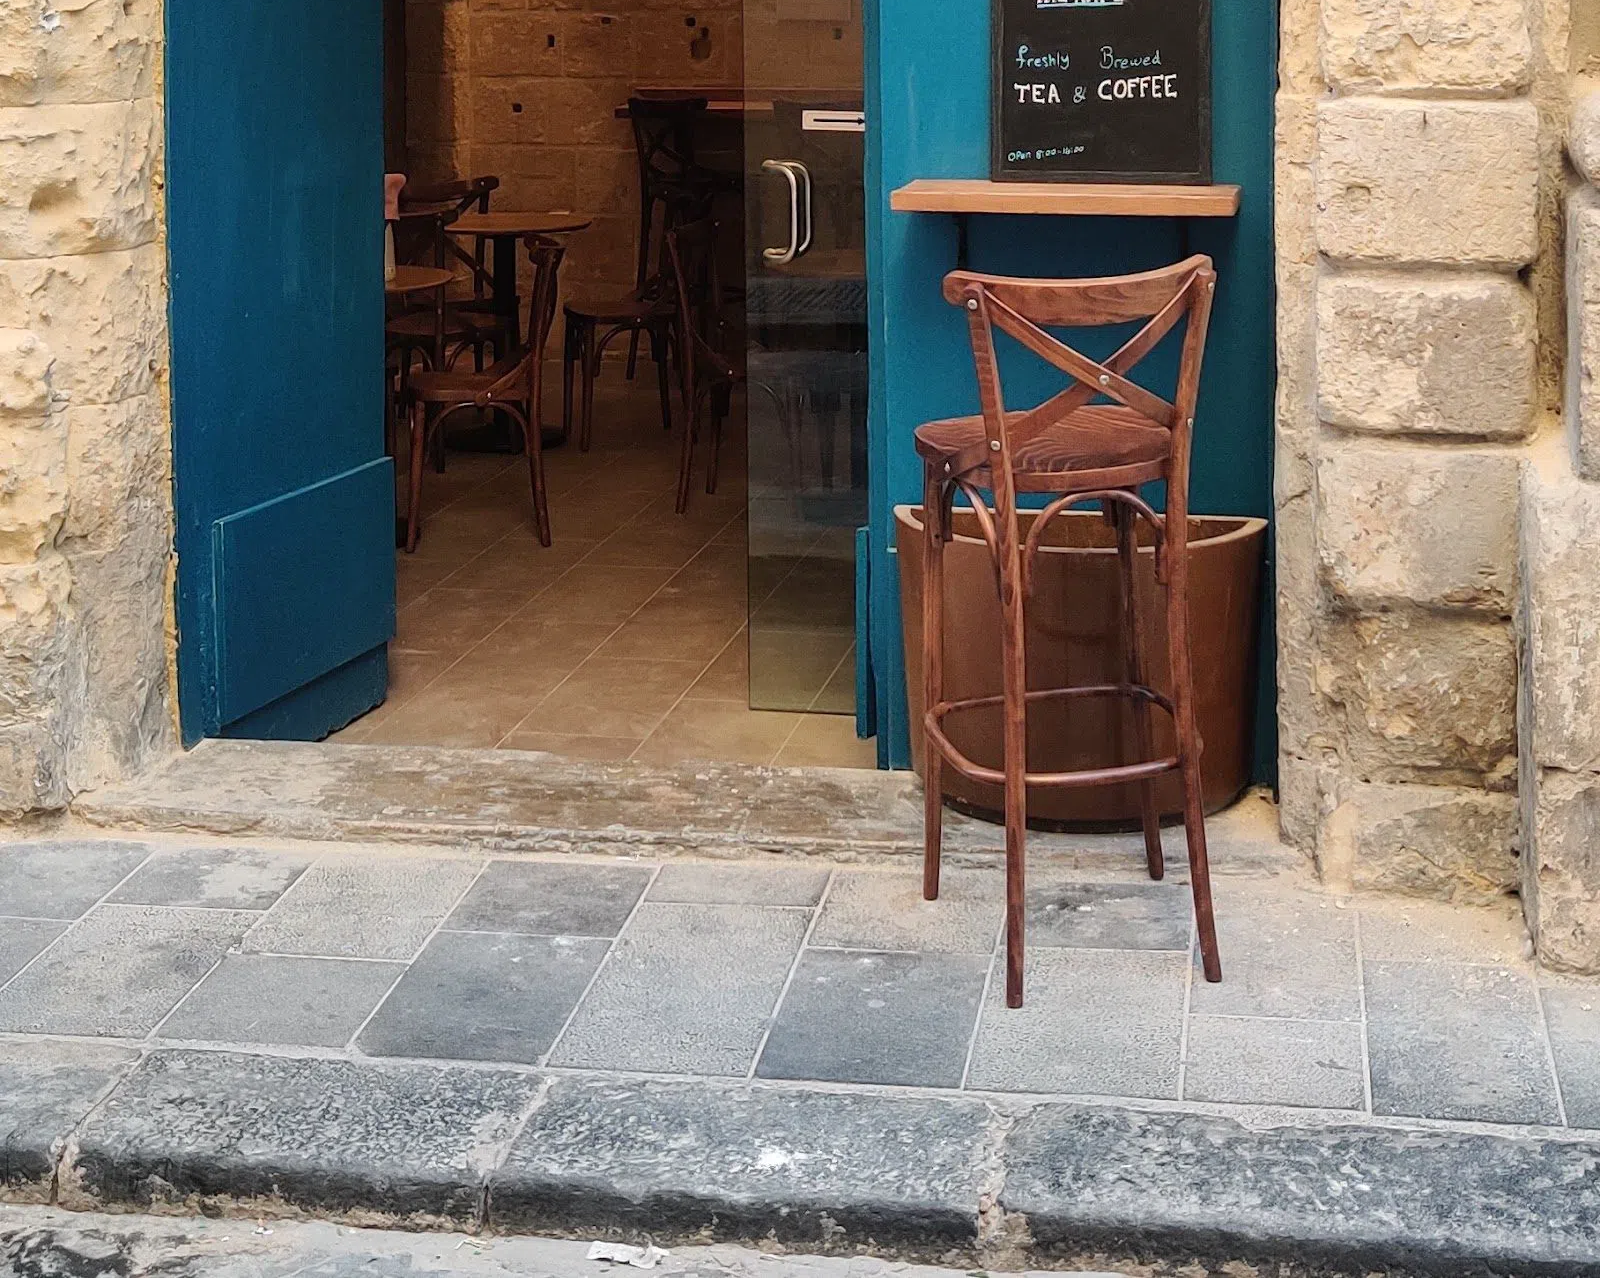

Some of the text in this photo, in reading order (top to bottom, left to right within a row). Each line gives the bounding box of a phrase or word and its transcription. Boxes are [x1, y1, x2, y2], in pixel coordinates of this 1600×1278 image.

[1099, 45, 1162, 70] Brewed
[1013, 74, 1178, 104] TEA & COFFEE
